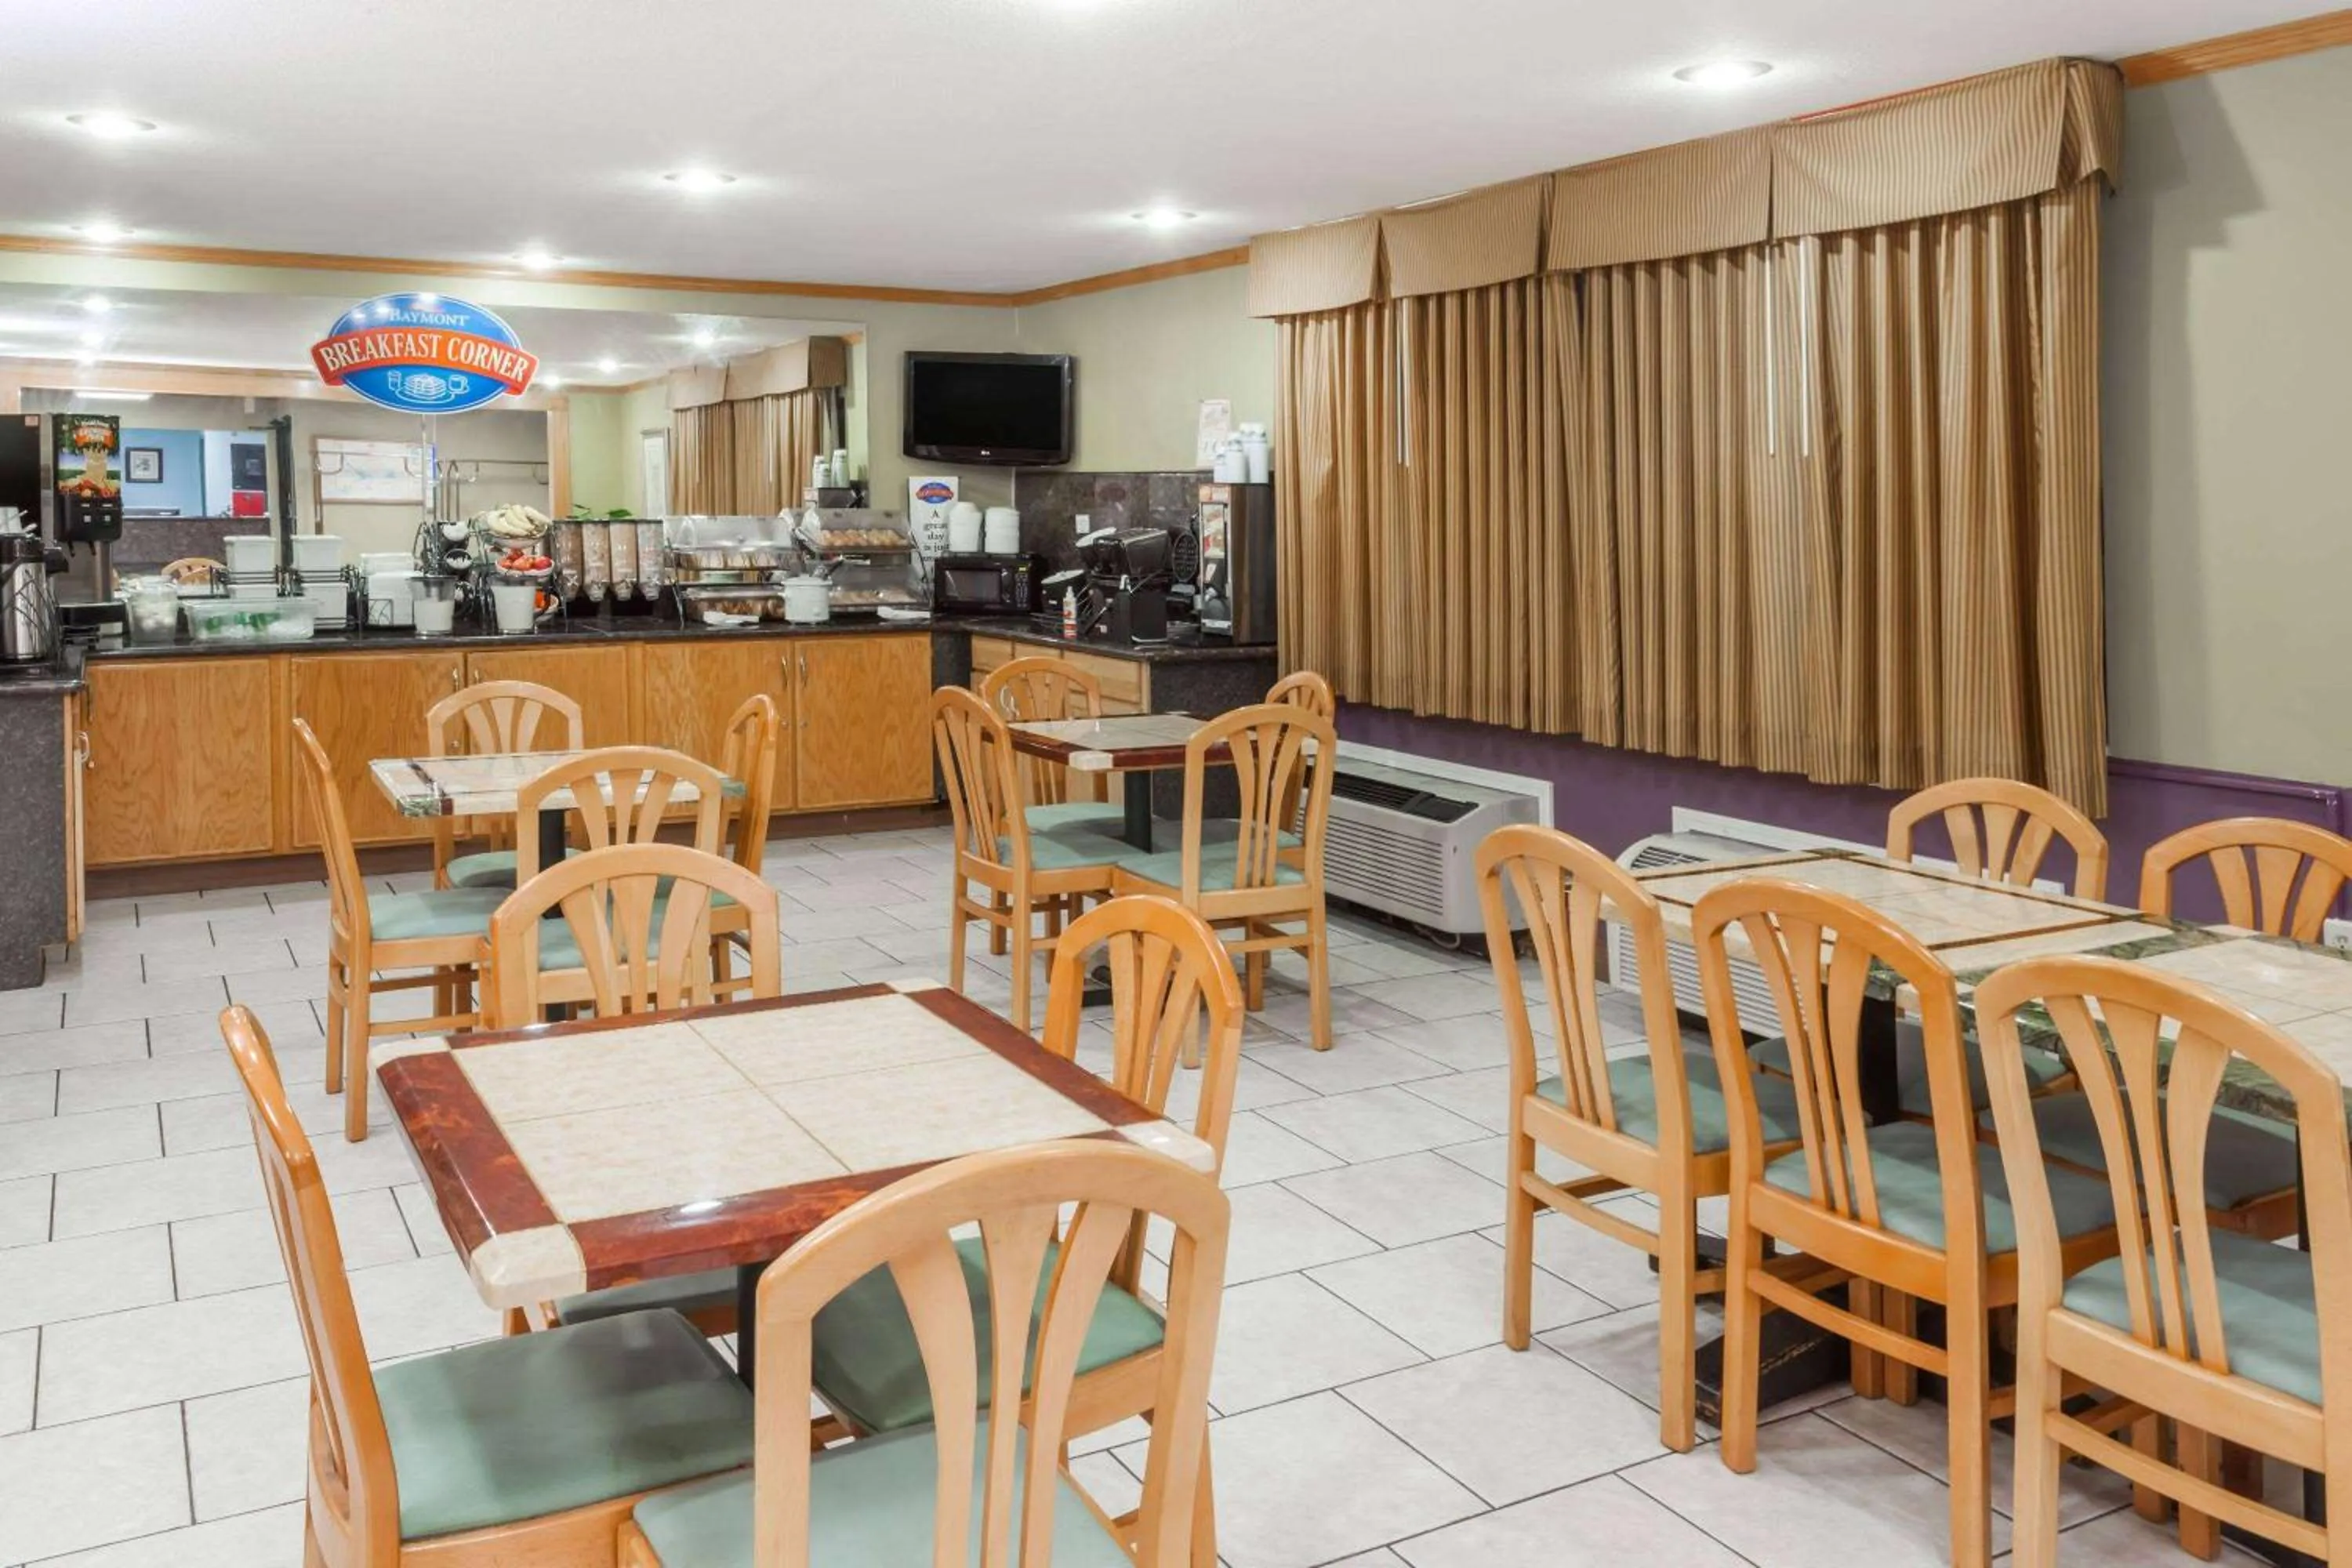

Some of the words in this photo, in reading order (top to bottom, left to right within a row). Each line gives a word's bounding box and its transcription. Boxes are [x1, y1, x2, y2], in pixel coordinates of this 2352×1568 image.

[390, 307, 466, 326] BAYMONT
[320, 332, 442, 372] BREAKFAST
[448, 336, 529, 383] CORNER
[931, 509, 941, 518] A
